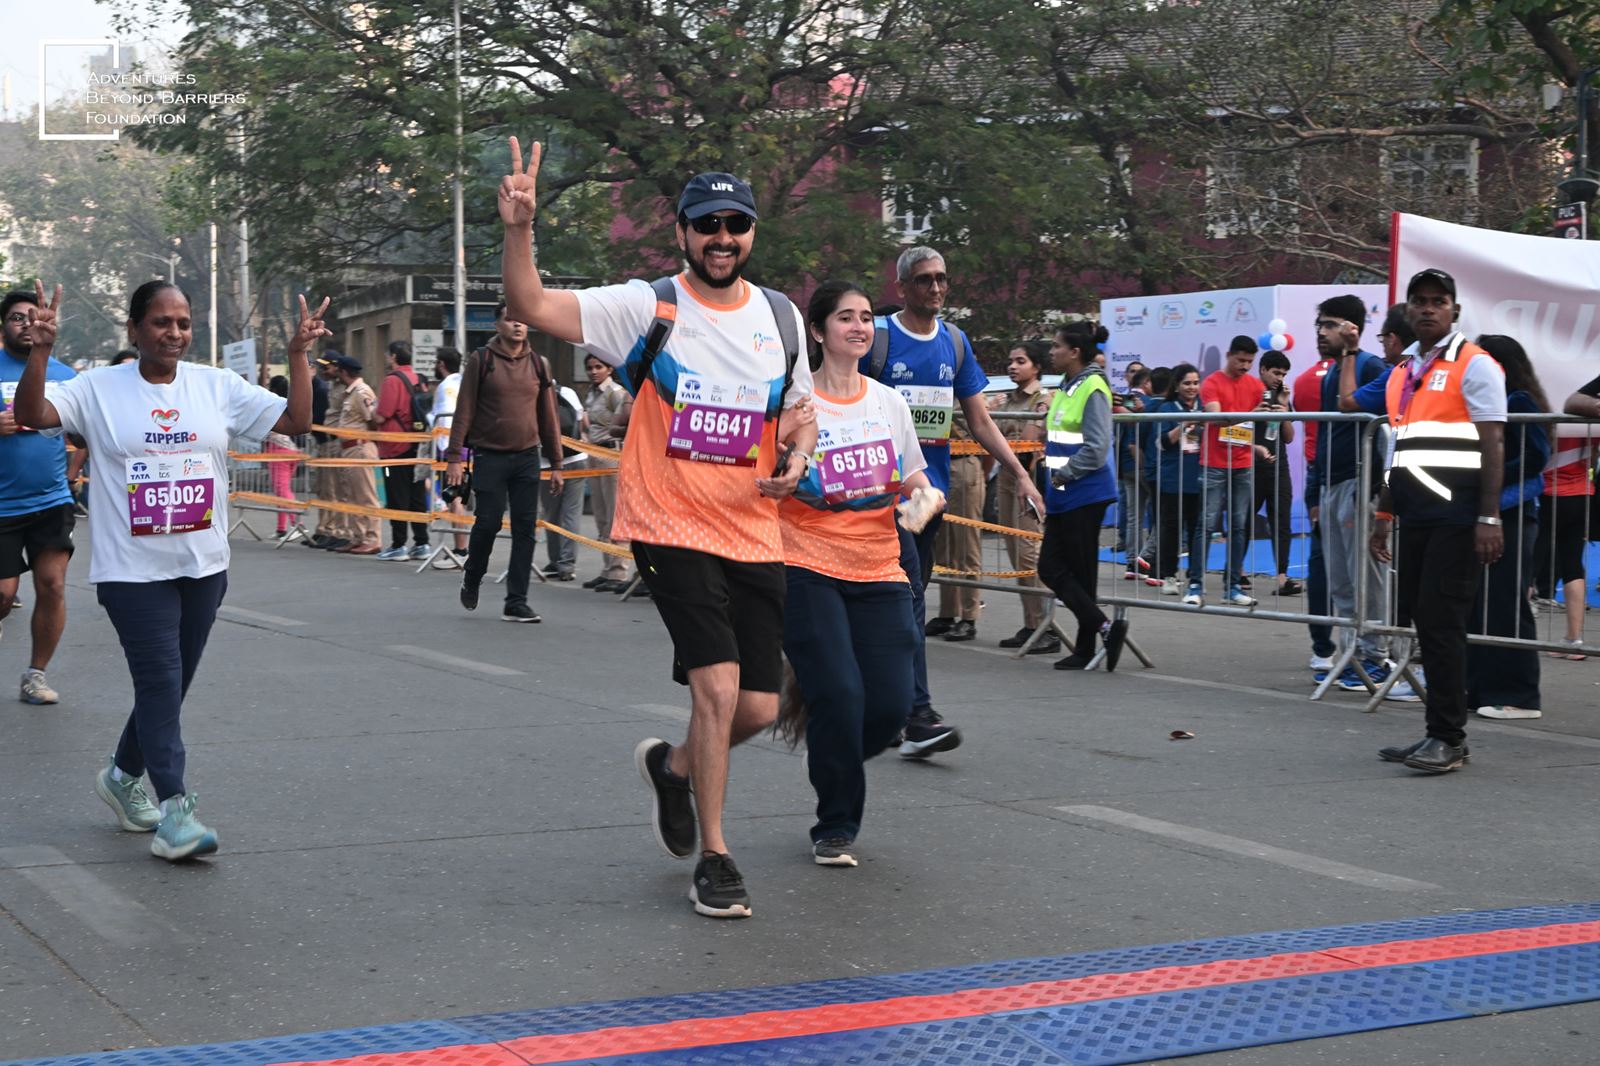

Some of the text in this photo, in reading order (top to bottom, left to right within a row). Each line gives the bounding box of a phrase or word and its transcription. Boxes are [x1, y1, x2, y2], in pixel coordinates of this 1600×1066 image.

[711, 182, 734, 192] LIFE
[1111, 352, 1142, 364] Running
[681, 391, 701, 400] TATA
[690, 408, 752, 438] 65641
[144, 431, 189, 445] ZIPPER
[831, 444, 889, 475] 65789
[131, 473, 150, 481] TATA
[144, 484, 206, 507] 65002
